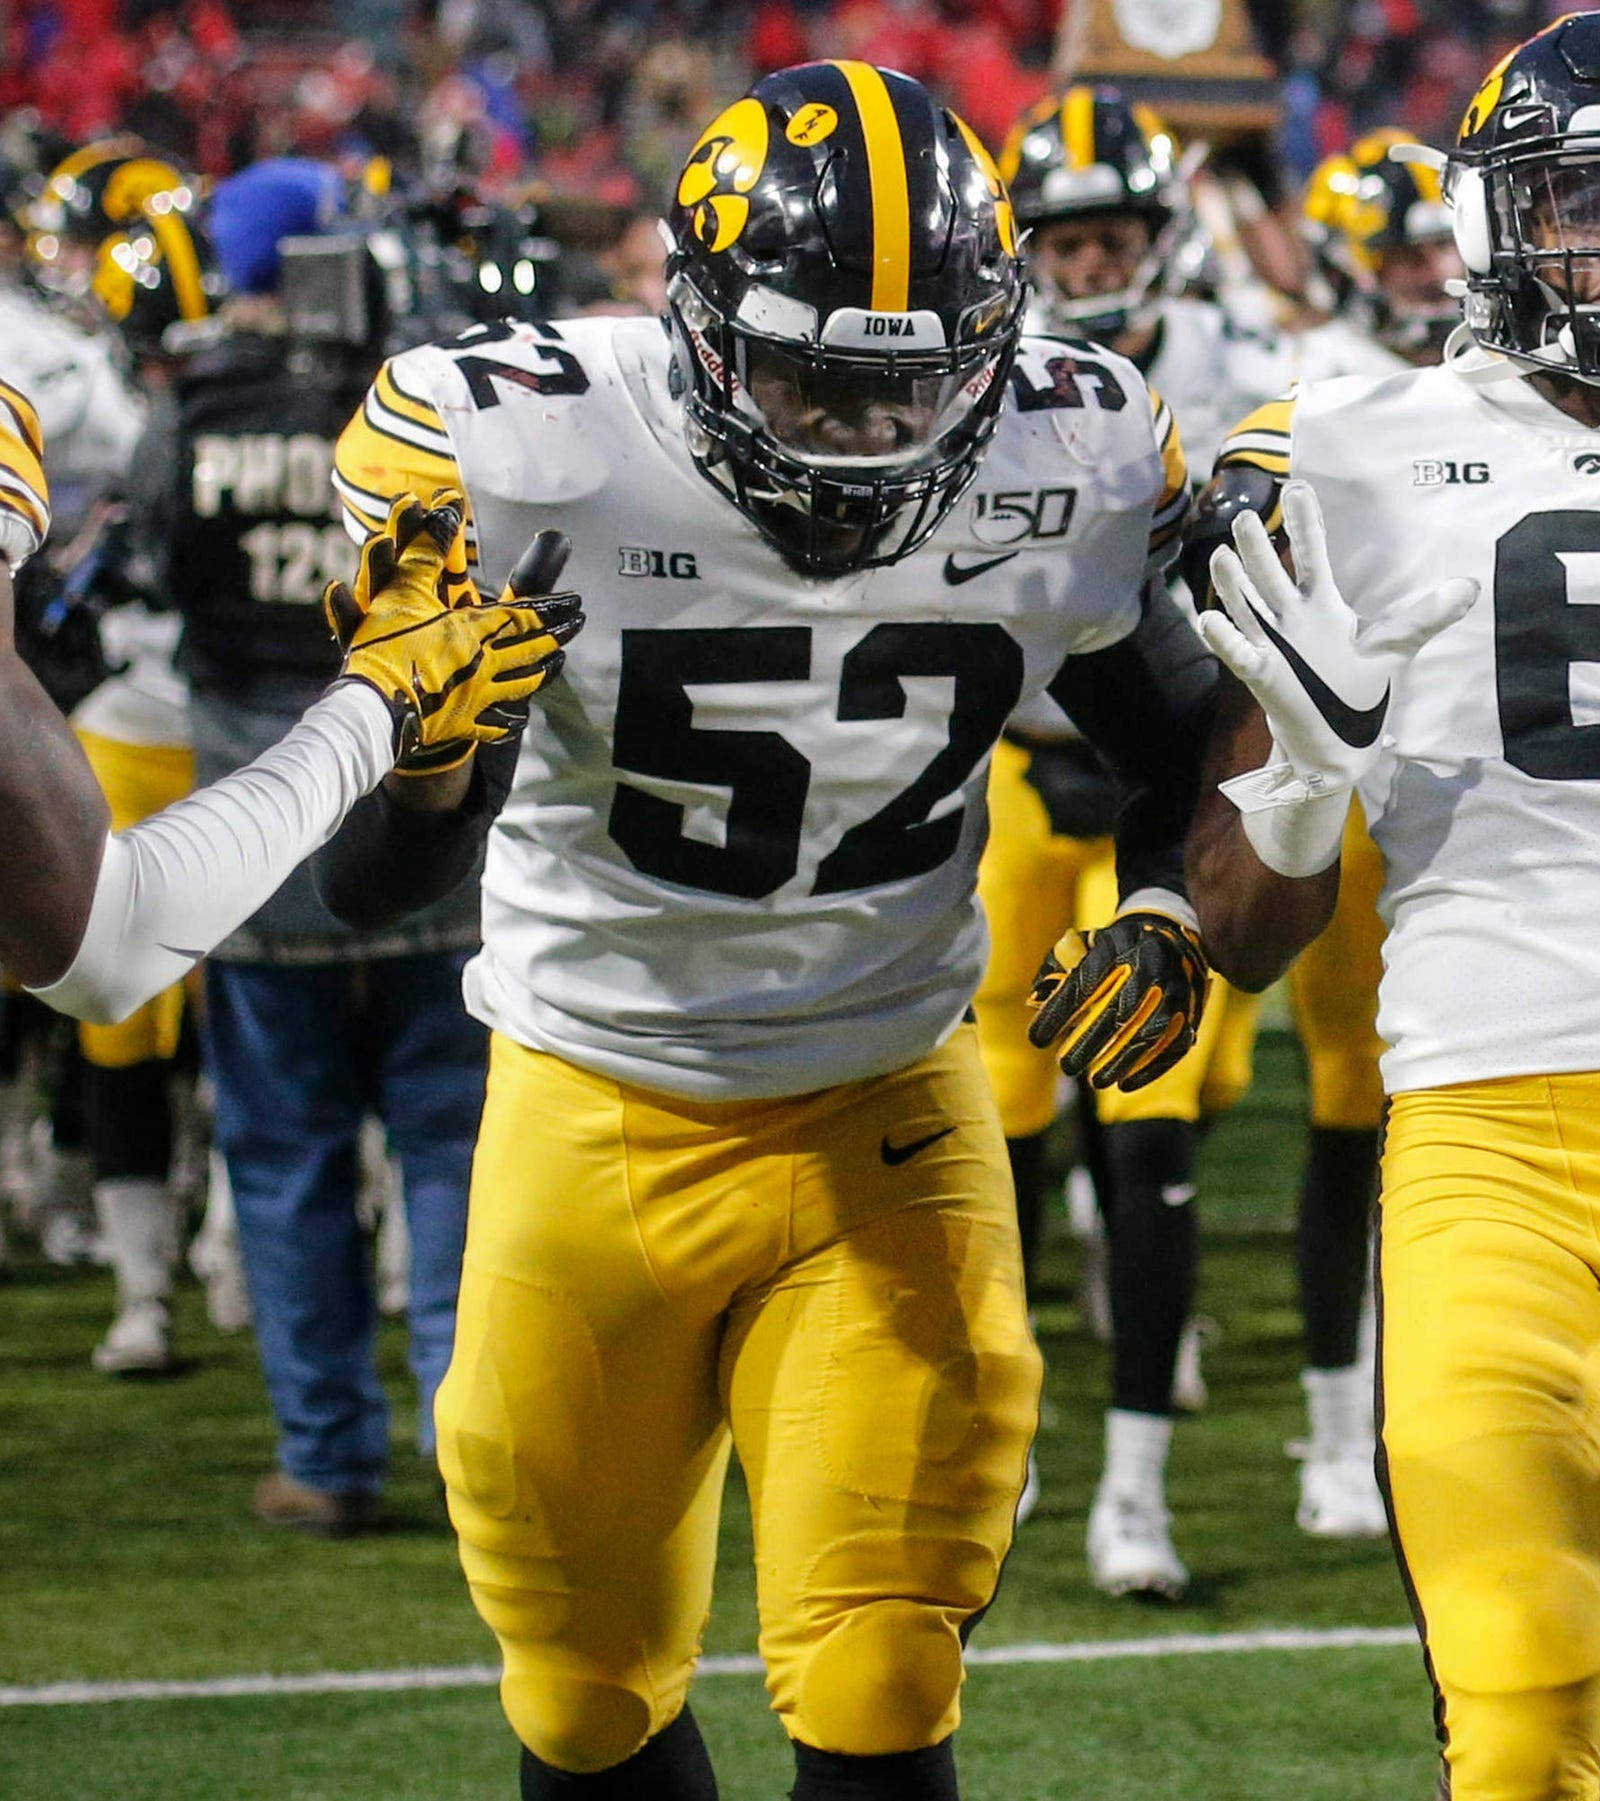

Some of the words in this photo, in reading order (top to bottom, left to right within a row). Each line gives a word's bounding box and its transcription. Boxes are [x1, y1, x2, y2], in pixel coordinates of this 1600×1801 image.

[863, 316, 915, 337] IOWA
[969, 487, 1078, 547] 150
[608, 622, 1025, 900] 52
